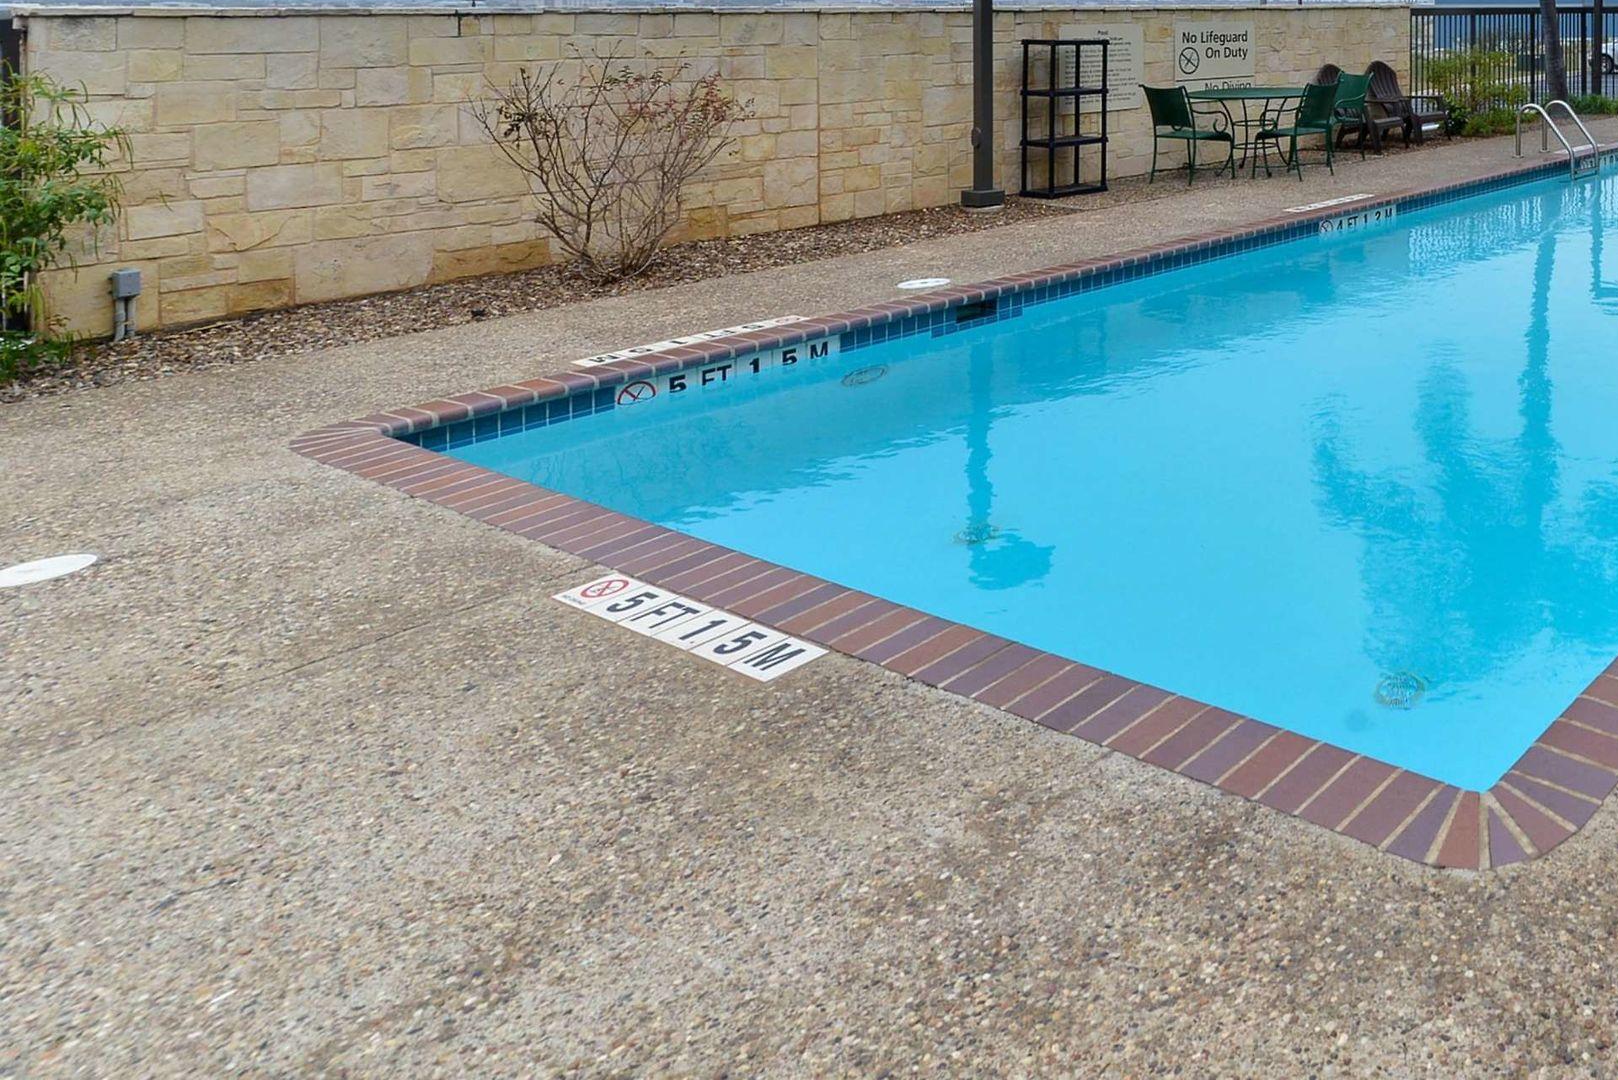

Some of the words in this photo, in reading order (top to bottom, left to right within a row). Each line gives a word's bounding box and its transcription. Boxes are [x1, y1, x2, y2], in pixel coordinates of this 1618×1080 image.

[1182, 32, 1197, 44] No
[1200, 30, 1248, 46] Lifeguard
[1205, 46, 1221, 59] On
[1223, 46, 1248, 60] Duty
[669, 374, 687, 393] 5
[702, 364, 732, 386] FT
[749, 357, 760, 374] 1
[782, 348, 798, 366] 5
[810, 341, 829, 360] M
[606, 592, 659, 613] 5
[630, 601, 700, 629] FT
[713, 631, 768, 655] 5
[743, 643, 807, 671] M
